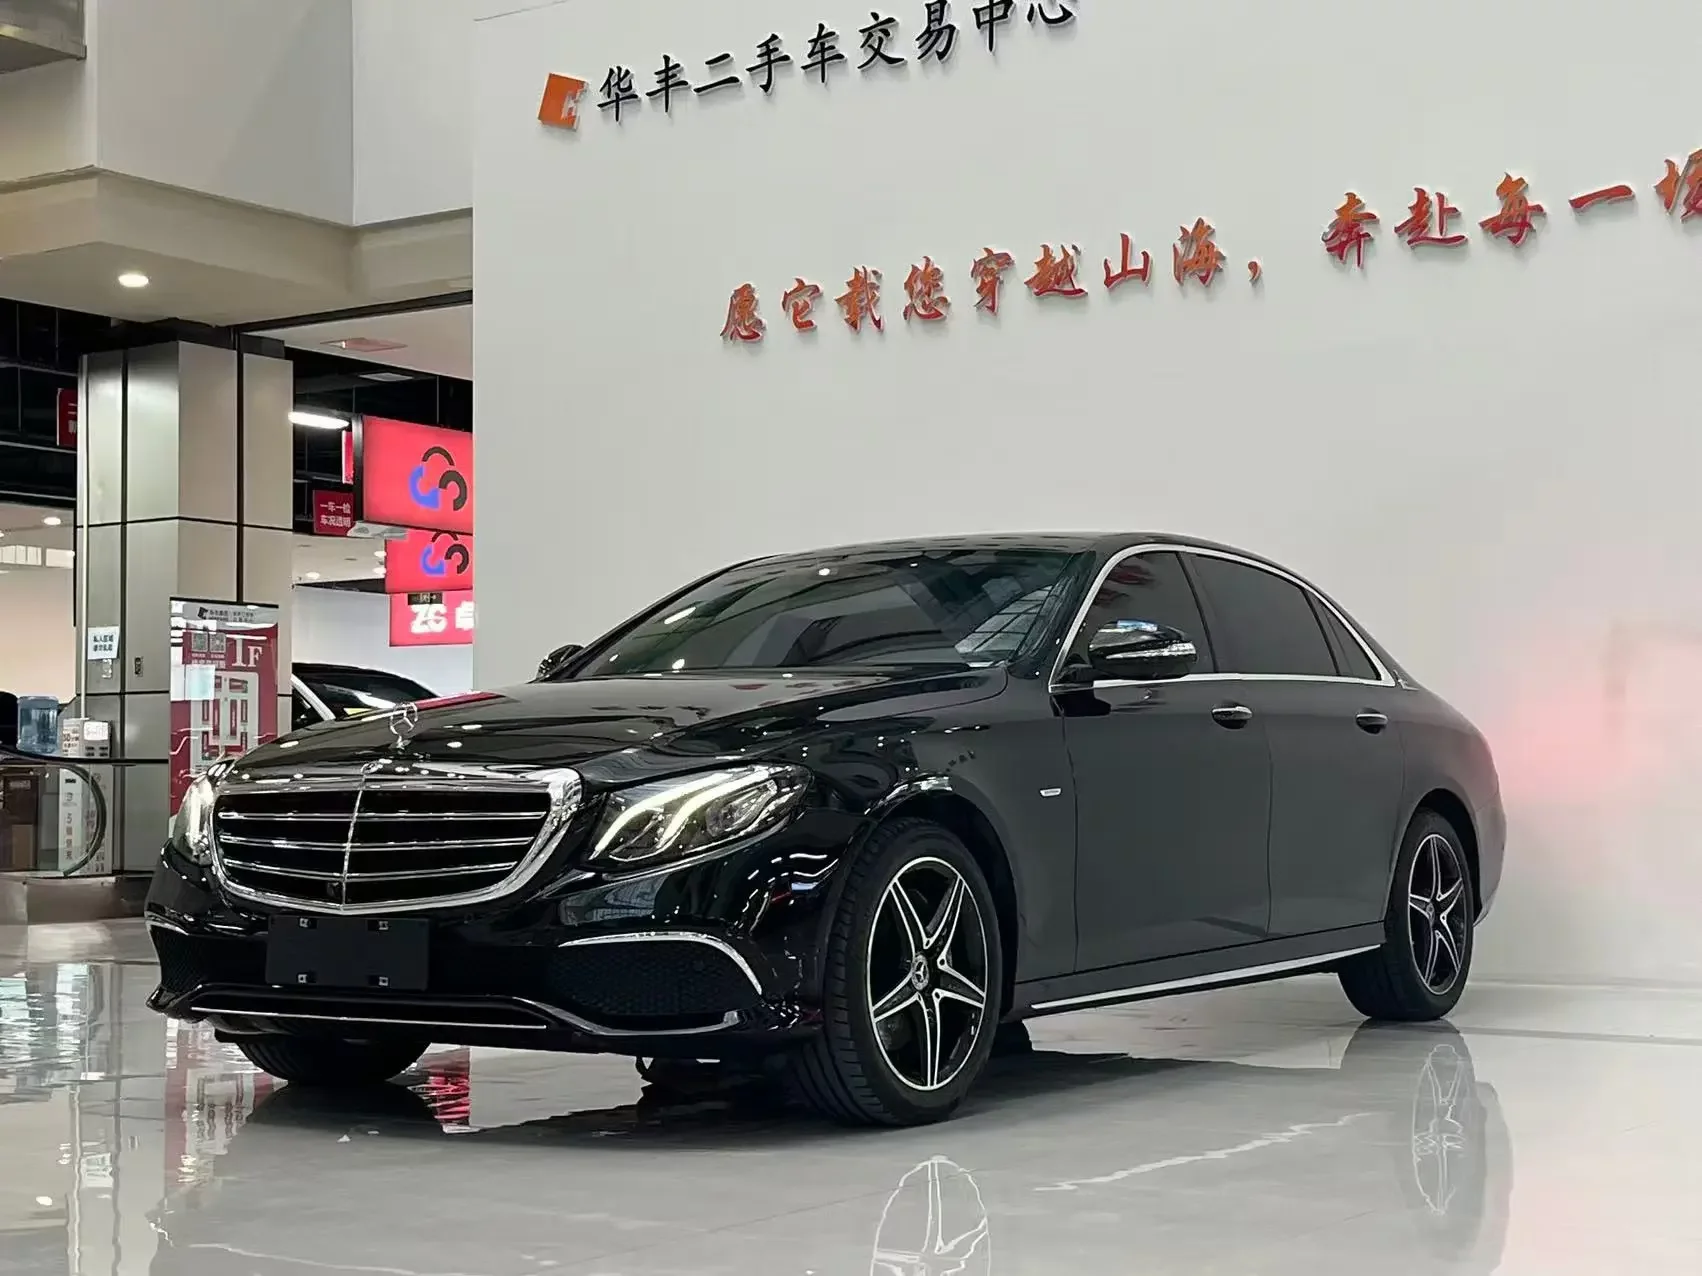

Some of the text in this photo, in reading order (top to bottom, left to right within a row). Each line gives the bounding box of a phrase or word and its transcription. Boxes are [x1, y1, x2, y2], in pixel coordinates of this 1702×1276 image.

[597, 0, 1074, 122] 华丰二手车交易中心
